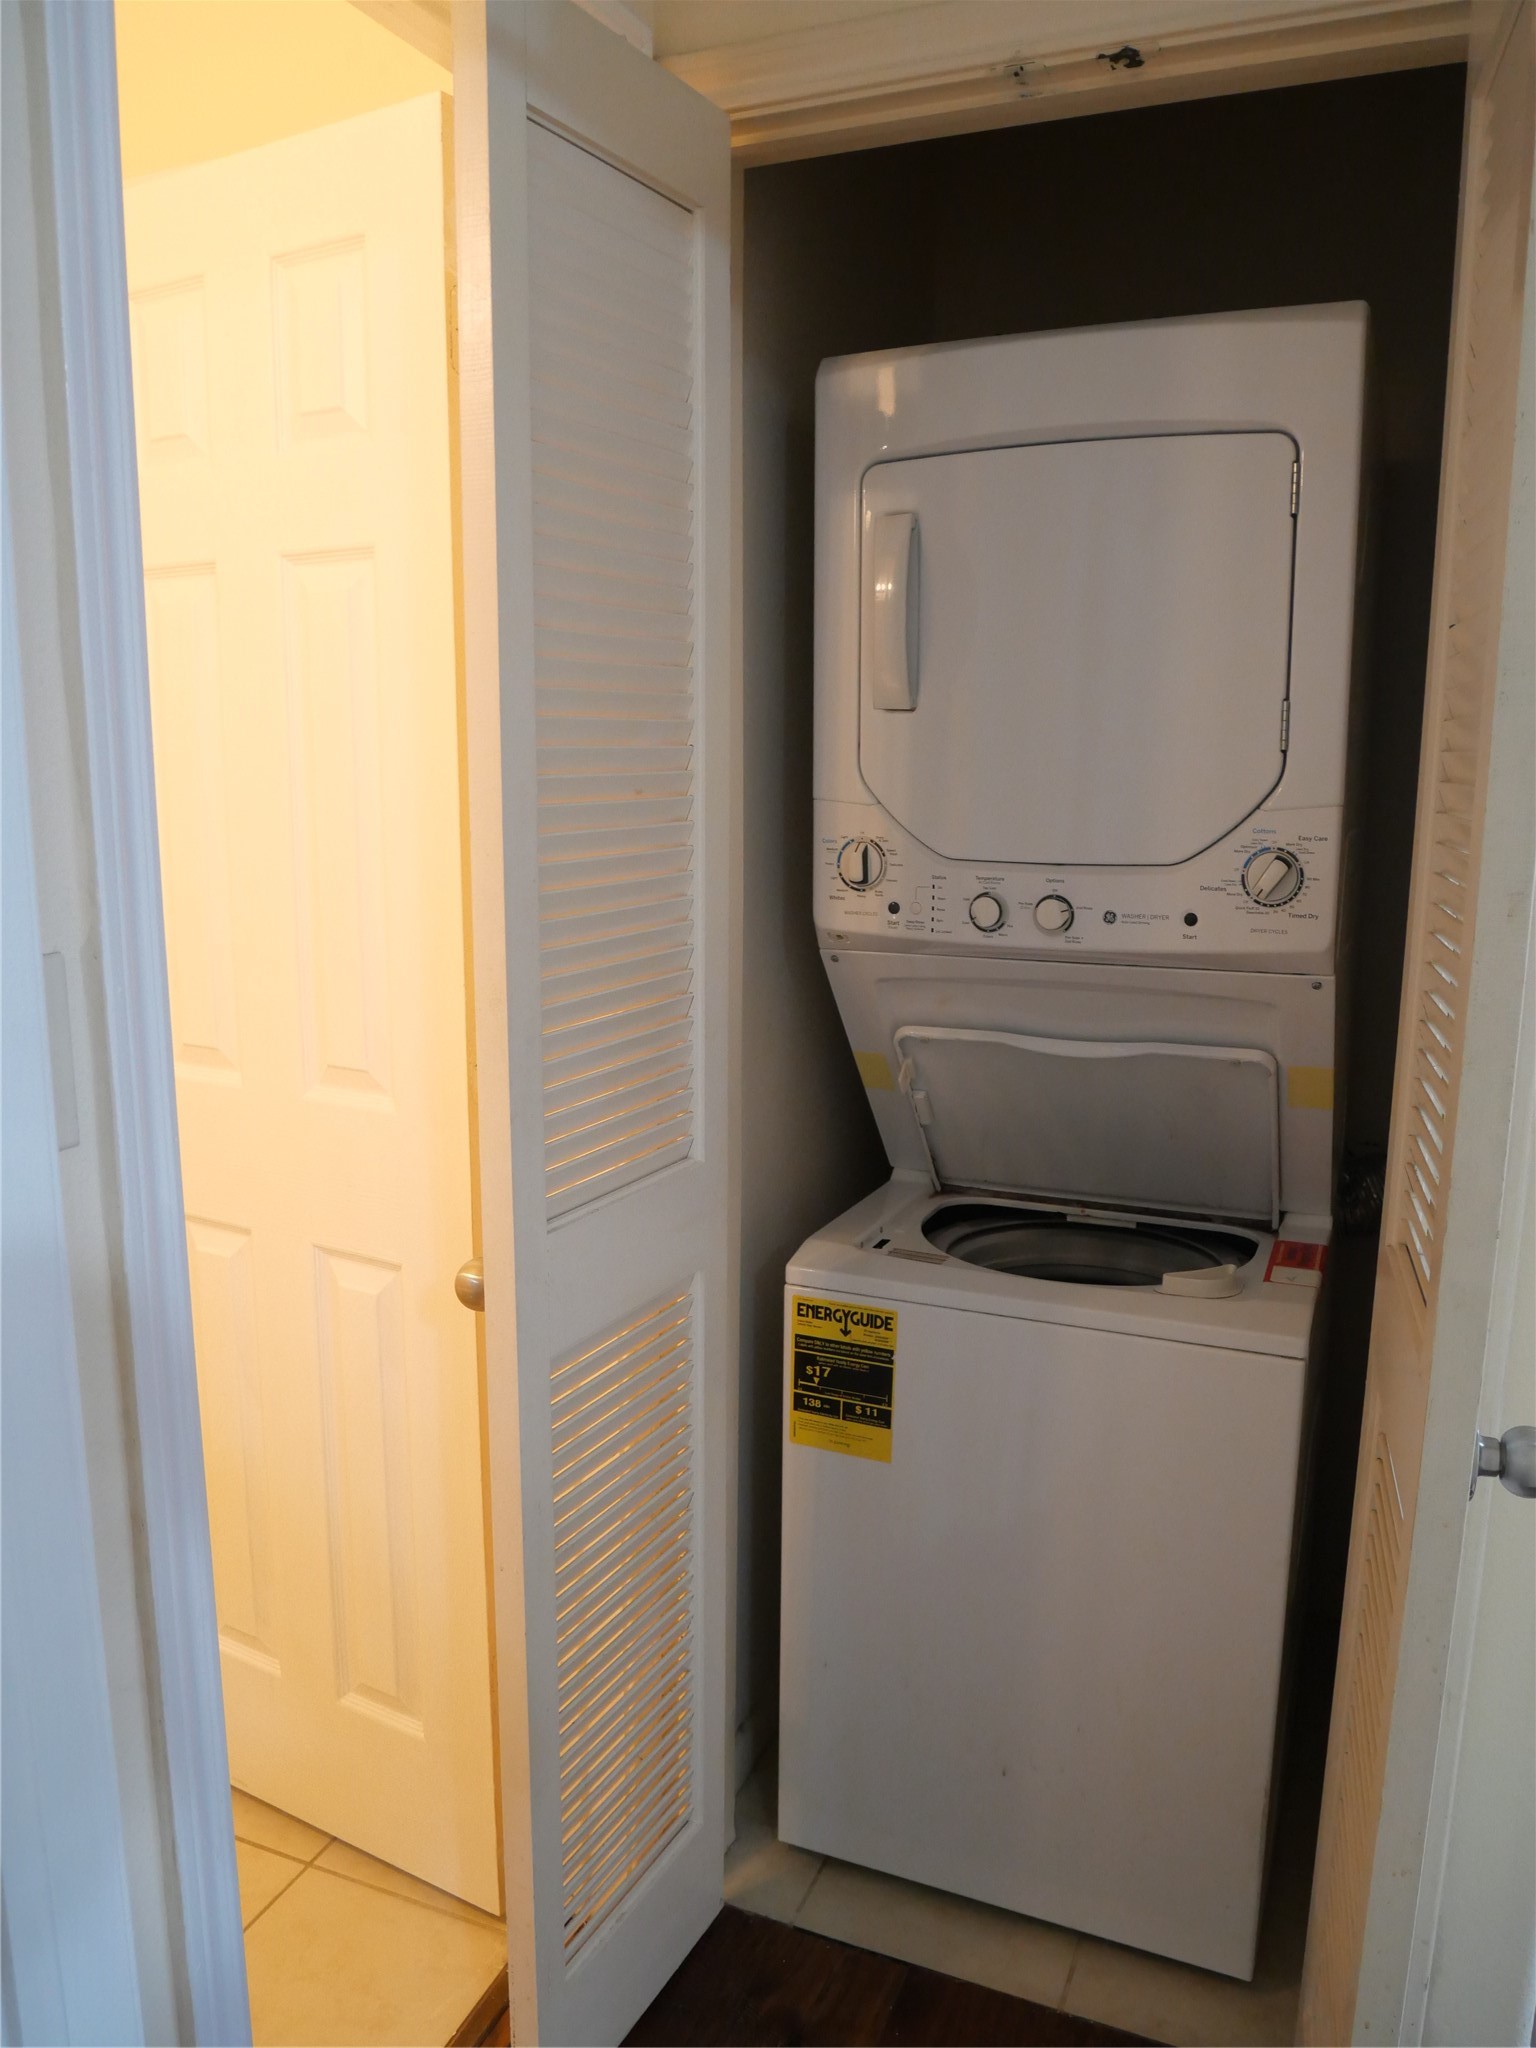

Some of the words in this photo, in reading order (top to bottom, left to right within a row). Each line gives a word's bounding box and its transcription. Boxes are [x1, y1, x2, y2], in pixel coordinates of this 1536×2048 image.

[796, 1302, 894, 1333] ENERGYGUIDE
[806, 1365, 832, 1378] $17
[802, 1397, 822, 1408] 138
